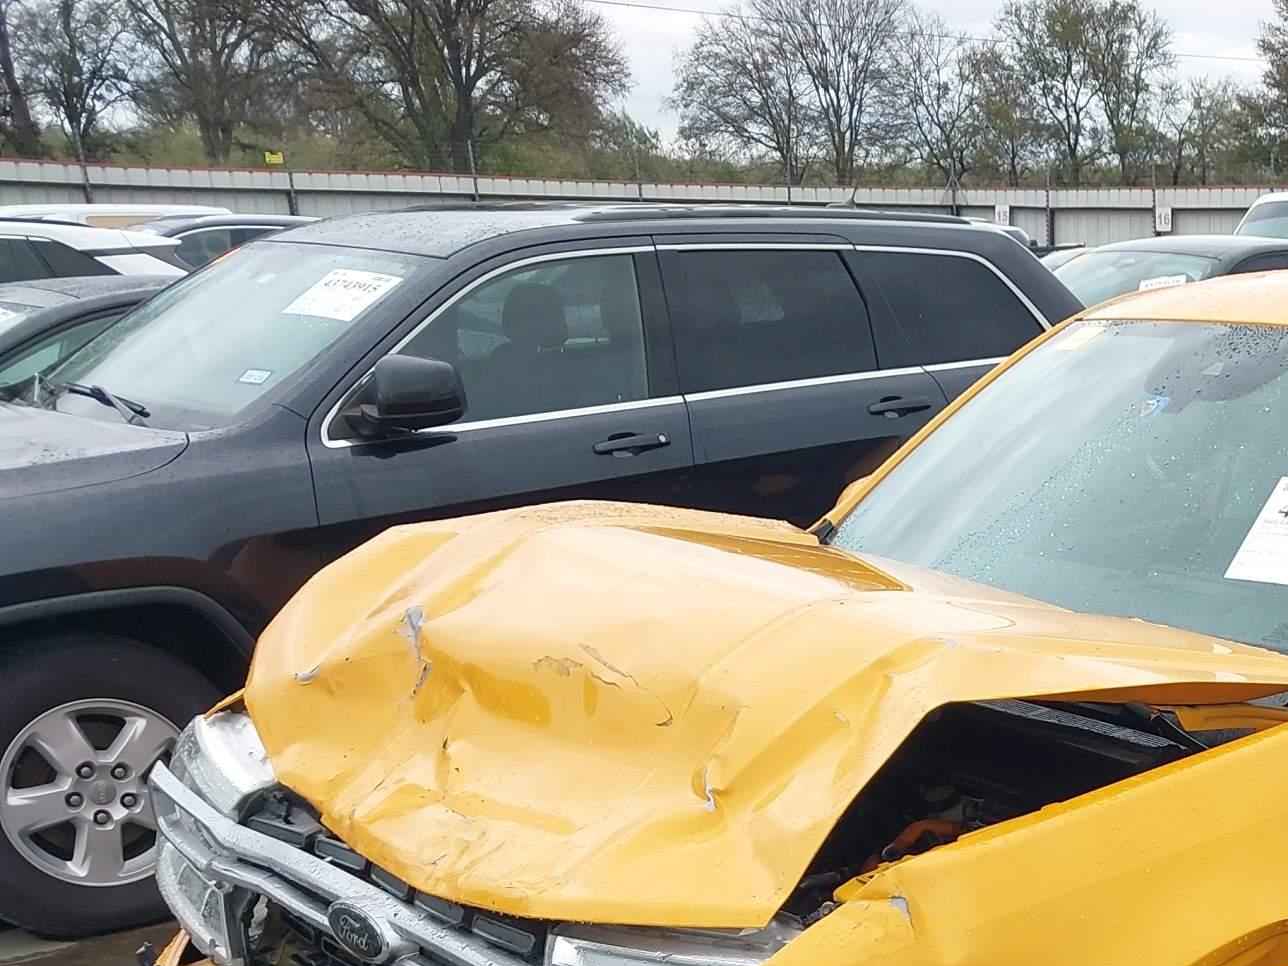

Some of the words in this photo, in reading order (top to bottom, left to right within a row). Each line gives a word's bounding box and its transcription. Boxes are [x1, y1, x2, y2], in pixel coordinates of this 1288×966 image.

[997, 210, 1008, 221] 15
[1158, 213, 1169, 225] 16
[339, 915, 369, 951] Ford
